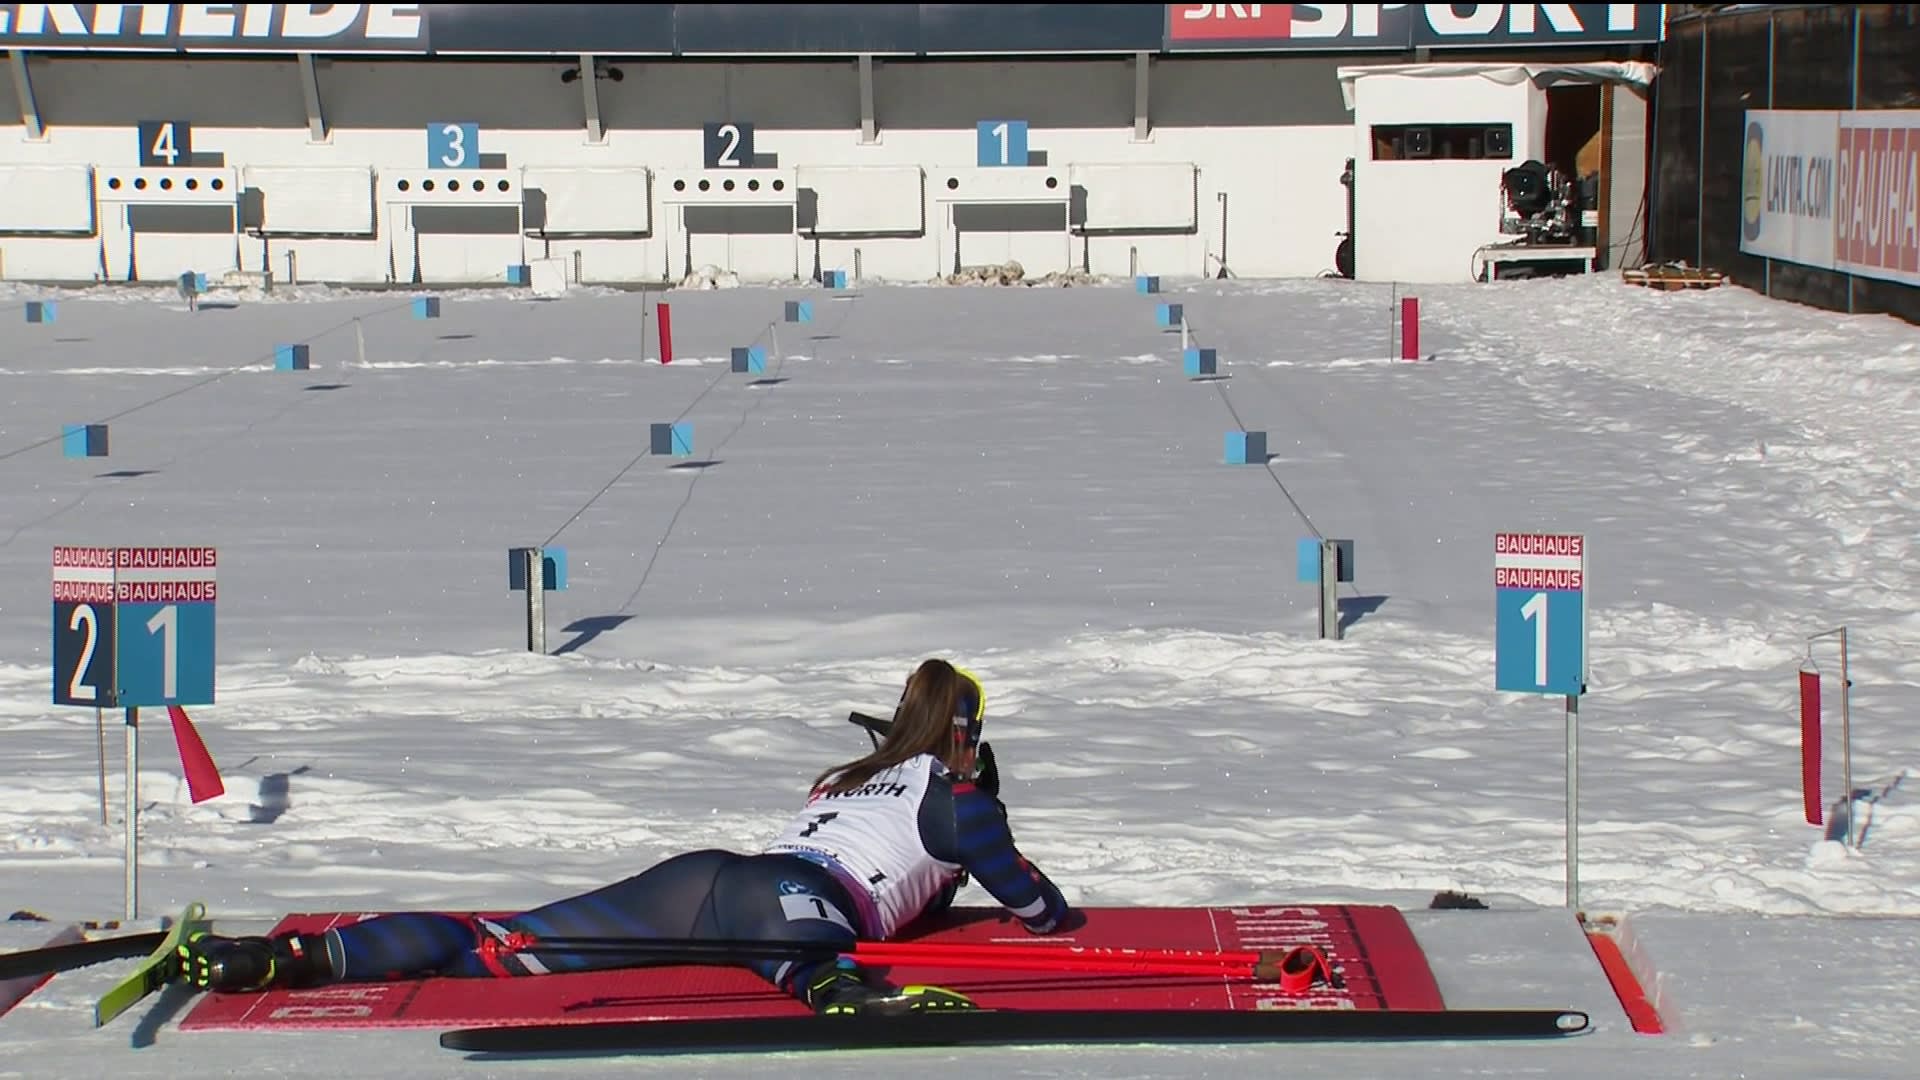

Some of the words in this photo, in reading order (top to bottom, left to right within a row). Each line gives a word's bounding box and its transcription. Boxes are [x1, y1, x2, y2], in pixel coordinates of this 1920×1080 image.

[152, 123, 179, 166] 4
[441, 124, 465, 167] 3
[717, 124, 741, 167] 2
[992, 122, 1009, 165] 1
[54, 550, 114, 566] BAUHAUS
[119, 550, 216, 566] BAUHAUS
[1496, 536, 1581, 555] BAUHAUS
[54, 583, 114, 599] BAUHAUS
[119, 583, 216, 599] BAUHAUS
[1496, 569, 1581, 588] BAUHAUS
[70, 603, 98, 700] 2
[147, 605, 177, 699] 1
[1520, 592, 1548, 687] 1
